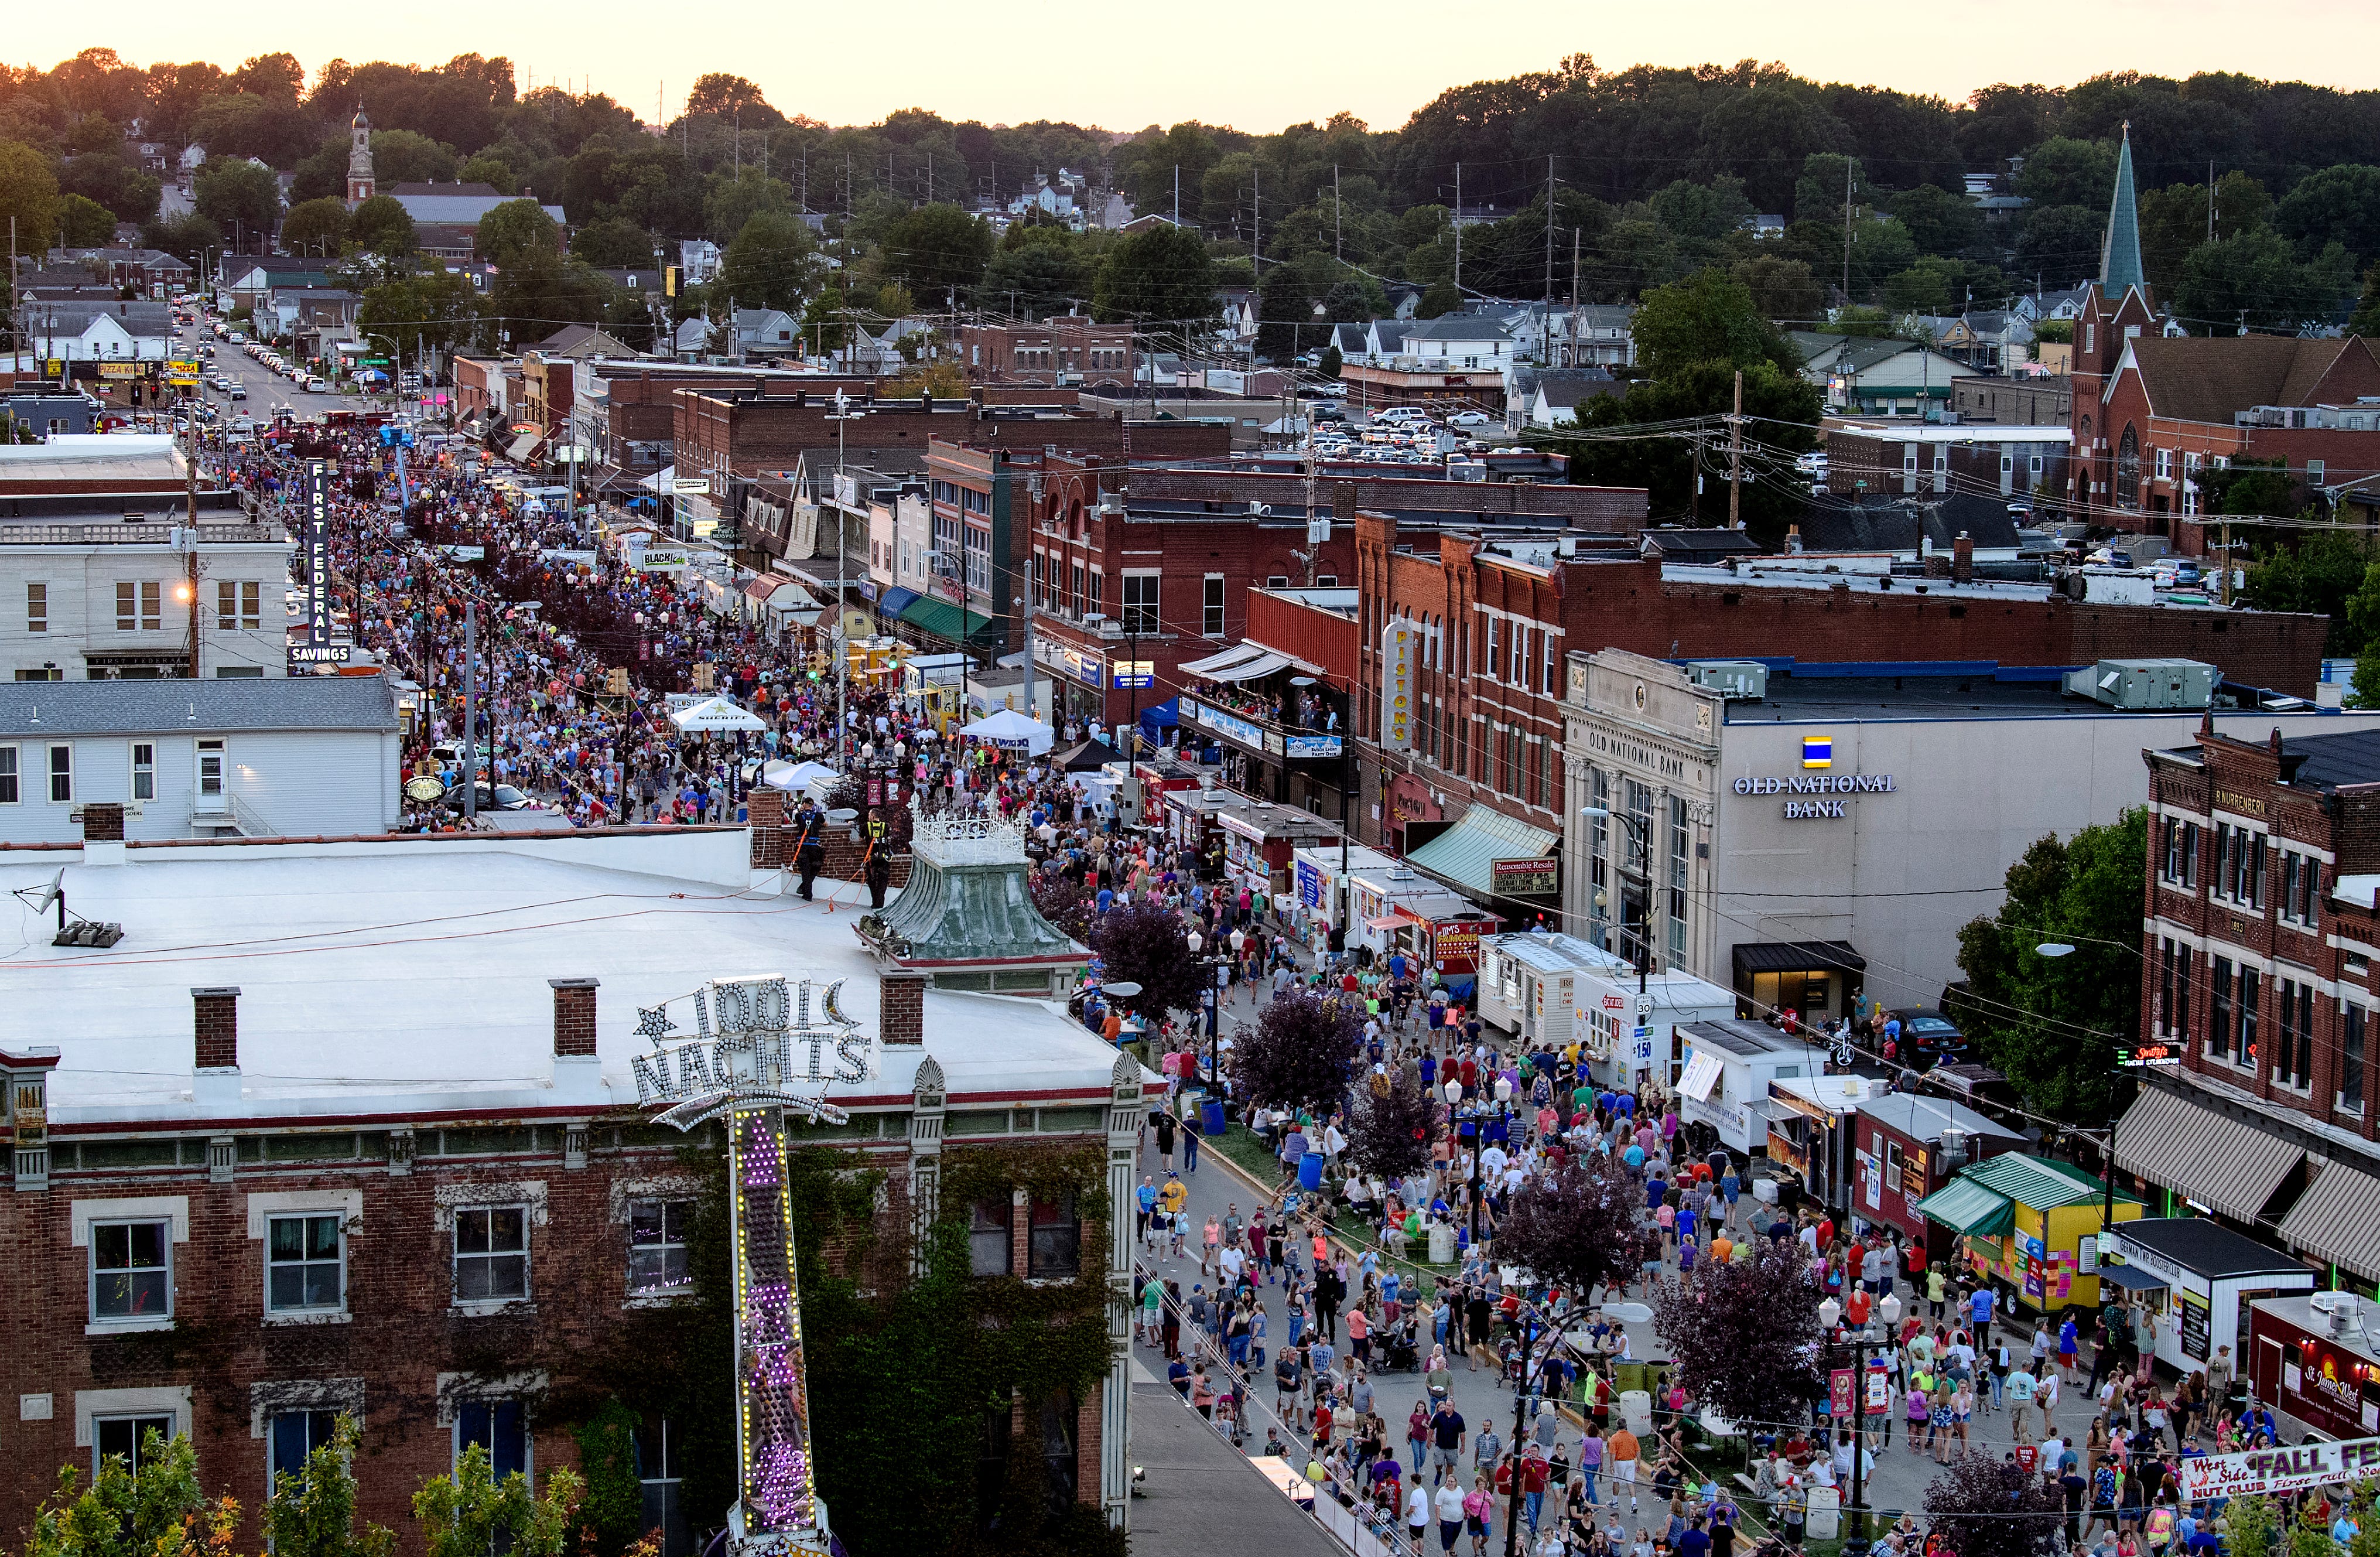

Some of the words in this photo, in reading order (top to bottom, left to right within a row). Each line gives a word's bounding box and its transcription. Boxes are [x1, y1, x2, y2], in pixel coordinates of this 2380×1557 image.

[100, 364, 122, 374] PIZZA
[312, 464, 324, 534] FIRST
[313, 543, 326, 642] FEDERAL
[292, 648, 348, 661] SAVINGS
[1393, 631, 1407, 741] PISTON'S
[1590, 732, 1606, 751] OLD
[1610, 739, 1655, 769] NATIONAL
[1660, 755, 1683, 778] BANK
[405, 787, 442, 797] TAVERN
[1734, 777, 1781, 794] OLD
[1786, 775, 1897, 794] NATIONAL
[1786, 800, 1846, 819] BANK
[1496, 862, 1531, 871] Reasonable
[1534, 861, 1554, 869] Resale
[1437, 933, 1478, 943] FAMOUS
[1638, 1004, 1650, 1013] 30
[631, 1033, 871, 1107] NACHTS
[2120, 1240, 2139, 1258] GERMAN
[2150, 1254, 2169, 1273] BOOSTER
[2169, 1264, 2180, 1279] CLUB
[2305, 1365, 2315, 1382] St.
[2317, 1370, 2338, 1392] James
[2340, 1381, 2358, 1402] West
[2191, 1457, 2227, 1472] West
[2256, 1447, 2330, 1480] FALL
[2340, 1440, 2380, 1470] FE
[2218, 1468, 2249, 1484] Side
[2273, 1477, 2311, 1488] First
[2191, 1486, 2223, 1499] NUT
[2227, 1481, 2266, 1495] CLUB
